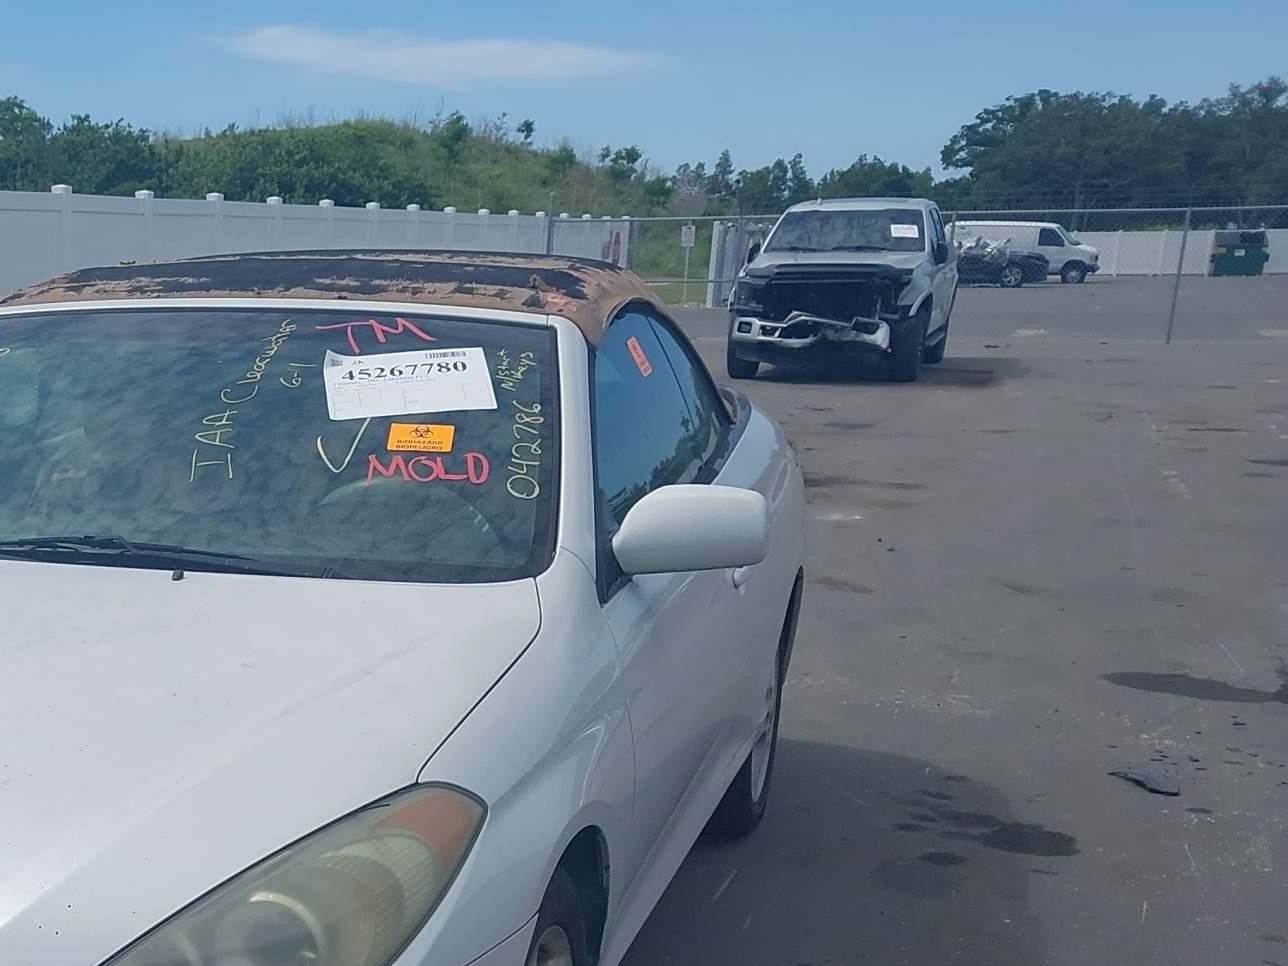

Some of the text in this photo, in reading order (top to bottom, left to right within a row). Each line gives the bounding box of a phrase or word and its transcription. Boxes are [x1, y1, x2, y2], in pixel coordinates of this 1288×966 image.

[315, 317, 439, 354] TM
[341, 360, 468, 382] 45267780
[189, 408, 239, 482] IAA
[506, 400, 544, 499] 042786
[364, 452, 489, 487] MOLD
